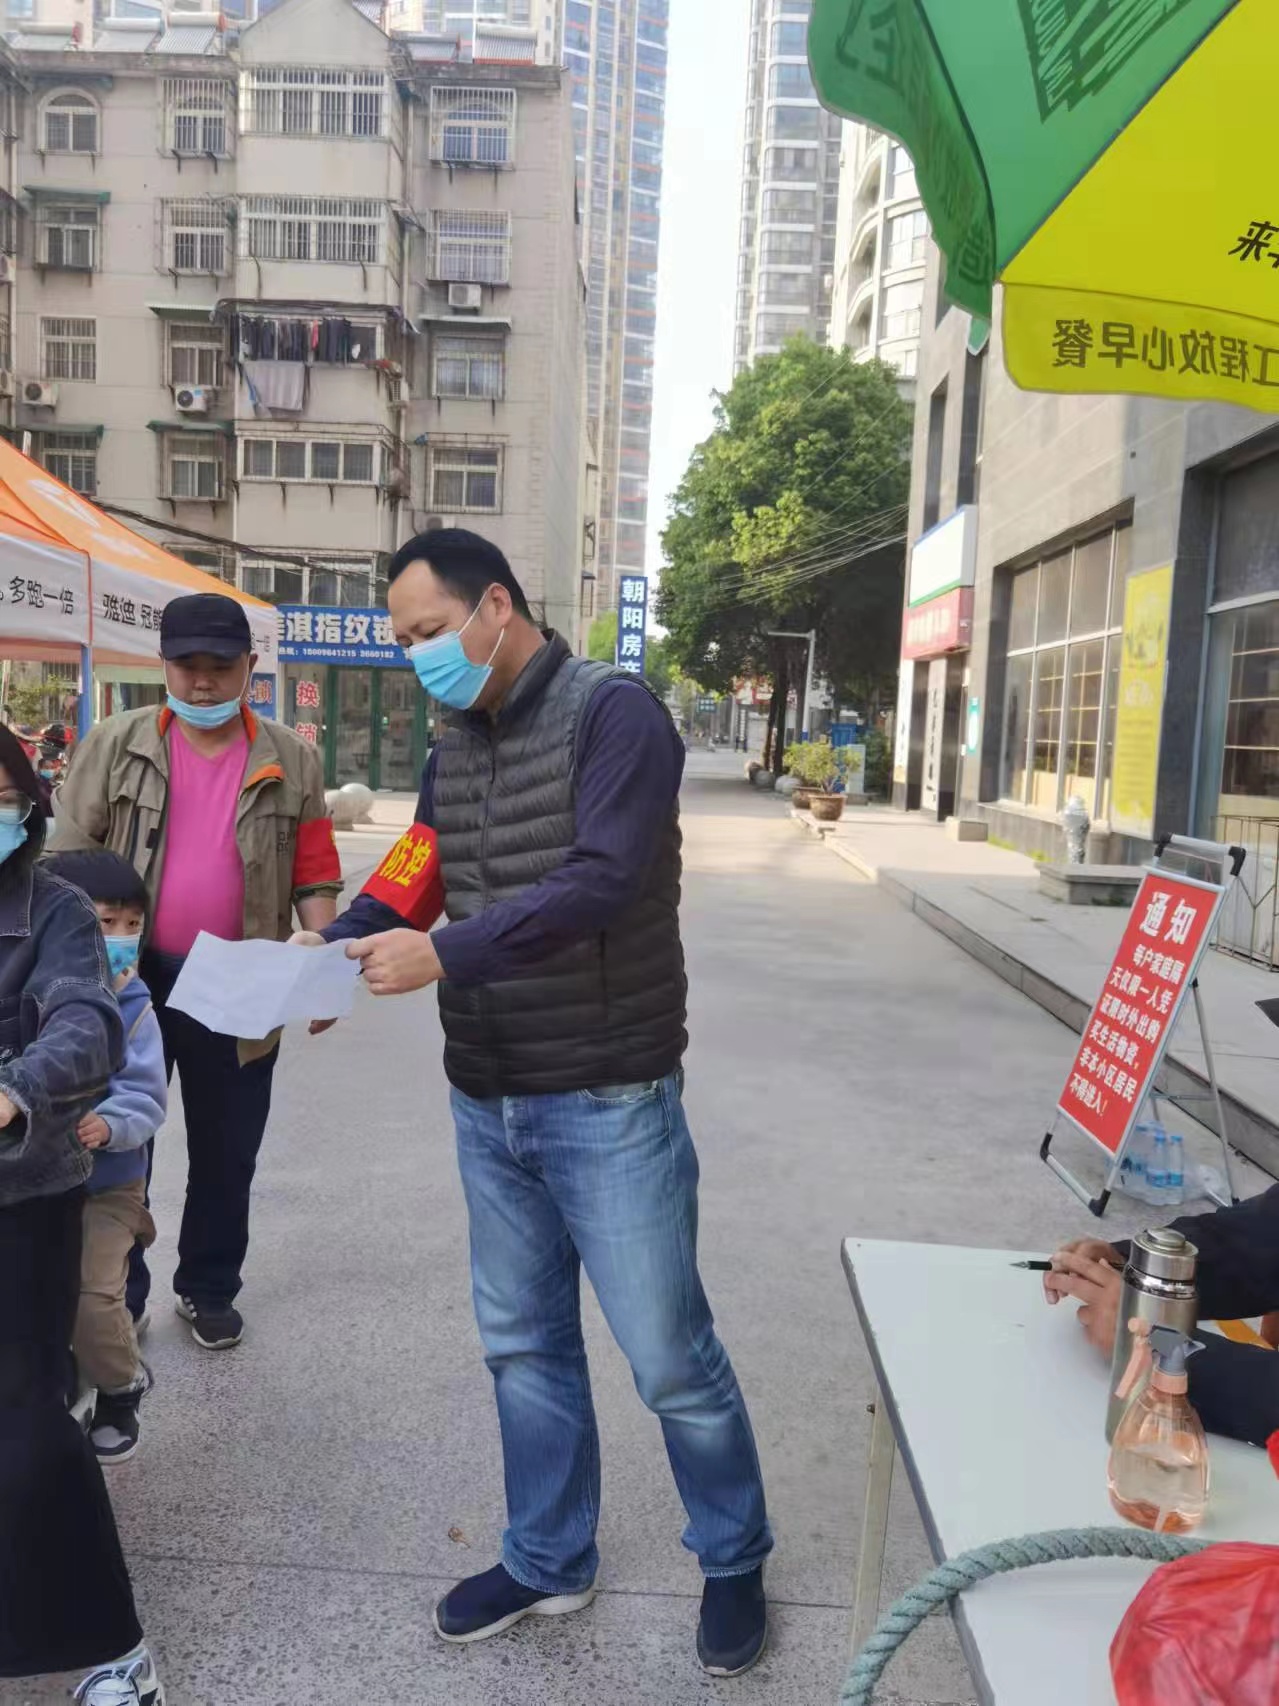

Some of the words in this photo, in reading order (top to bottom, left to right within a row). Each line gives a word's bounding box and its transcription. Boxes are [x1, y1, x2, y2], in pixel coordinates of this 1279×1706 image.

[9, 575, 75, 616] 多跑一倍
[102, 593, 137, 626] 雅迪
[379, 833, 432, 887] 防控
[1139, 891, 1198, 945] 通知
[1132, 943, 1185, 985] 每户家庭隔
[1109, 966, 1174, 1014] 天仅限一人凭
